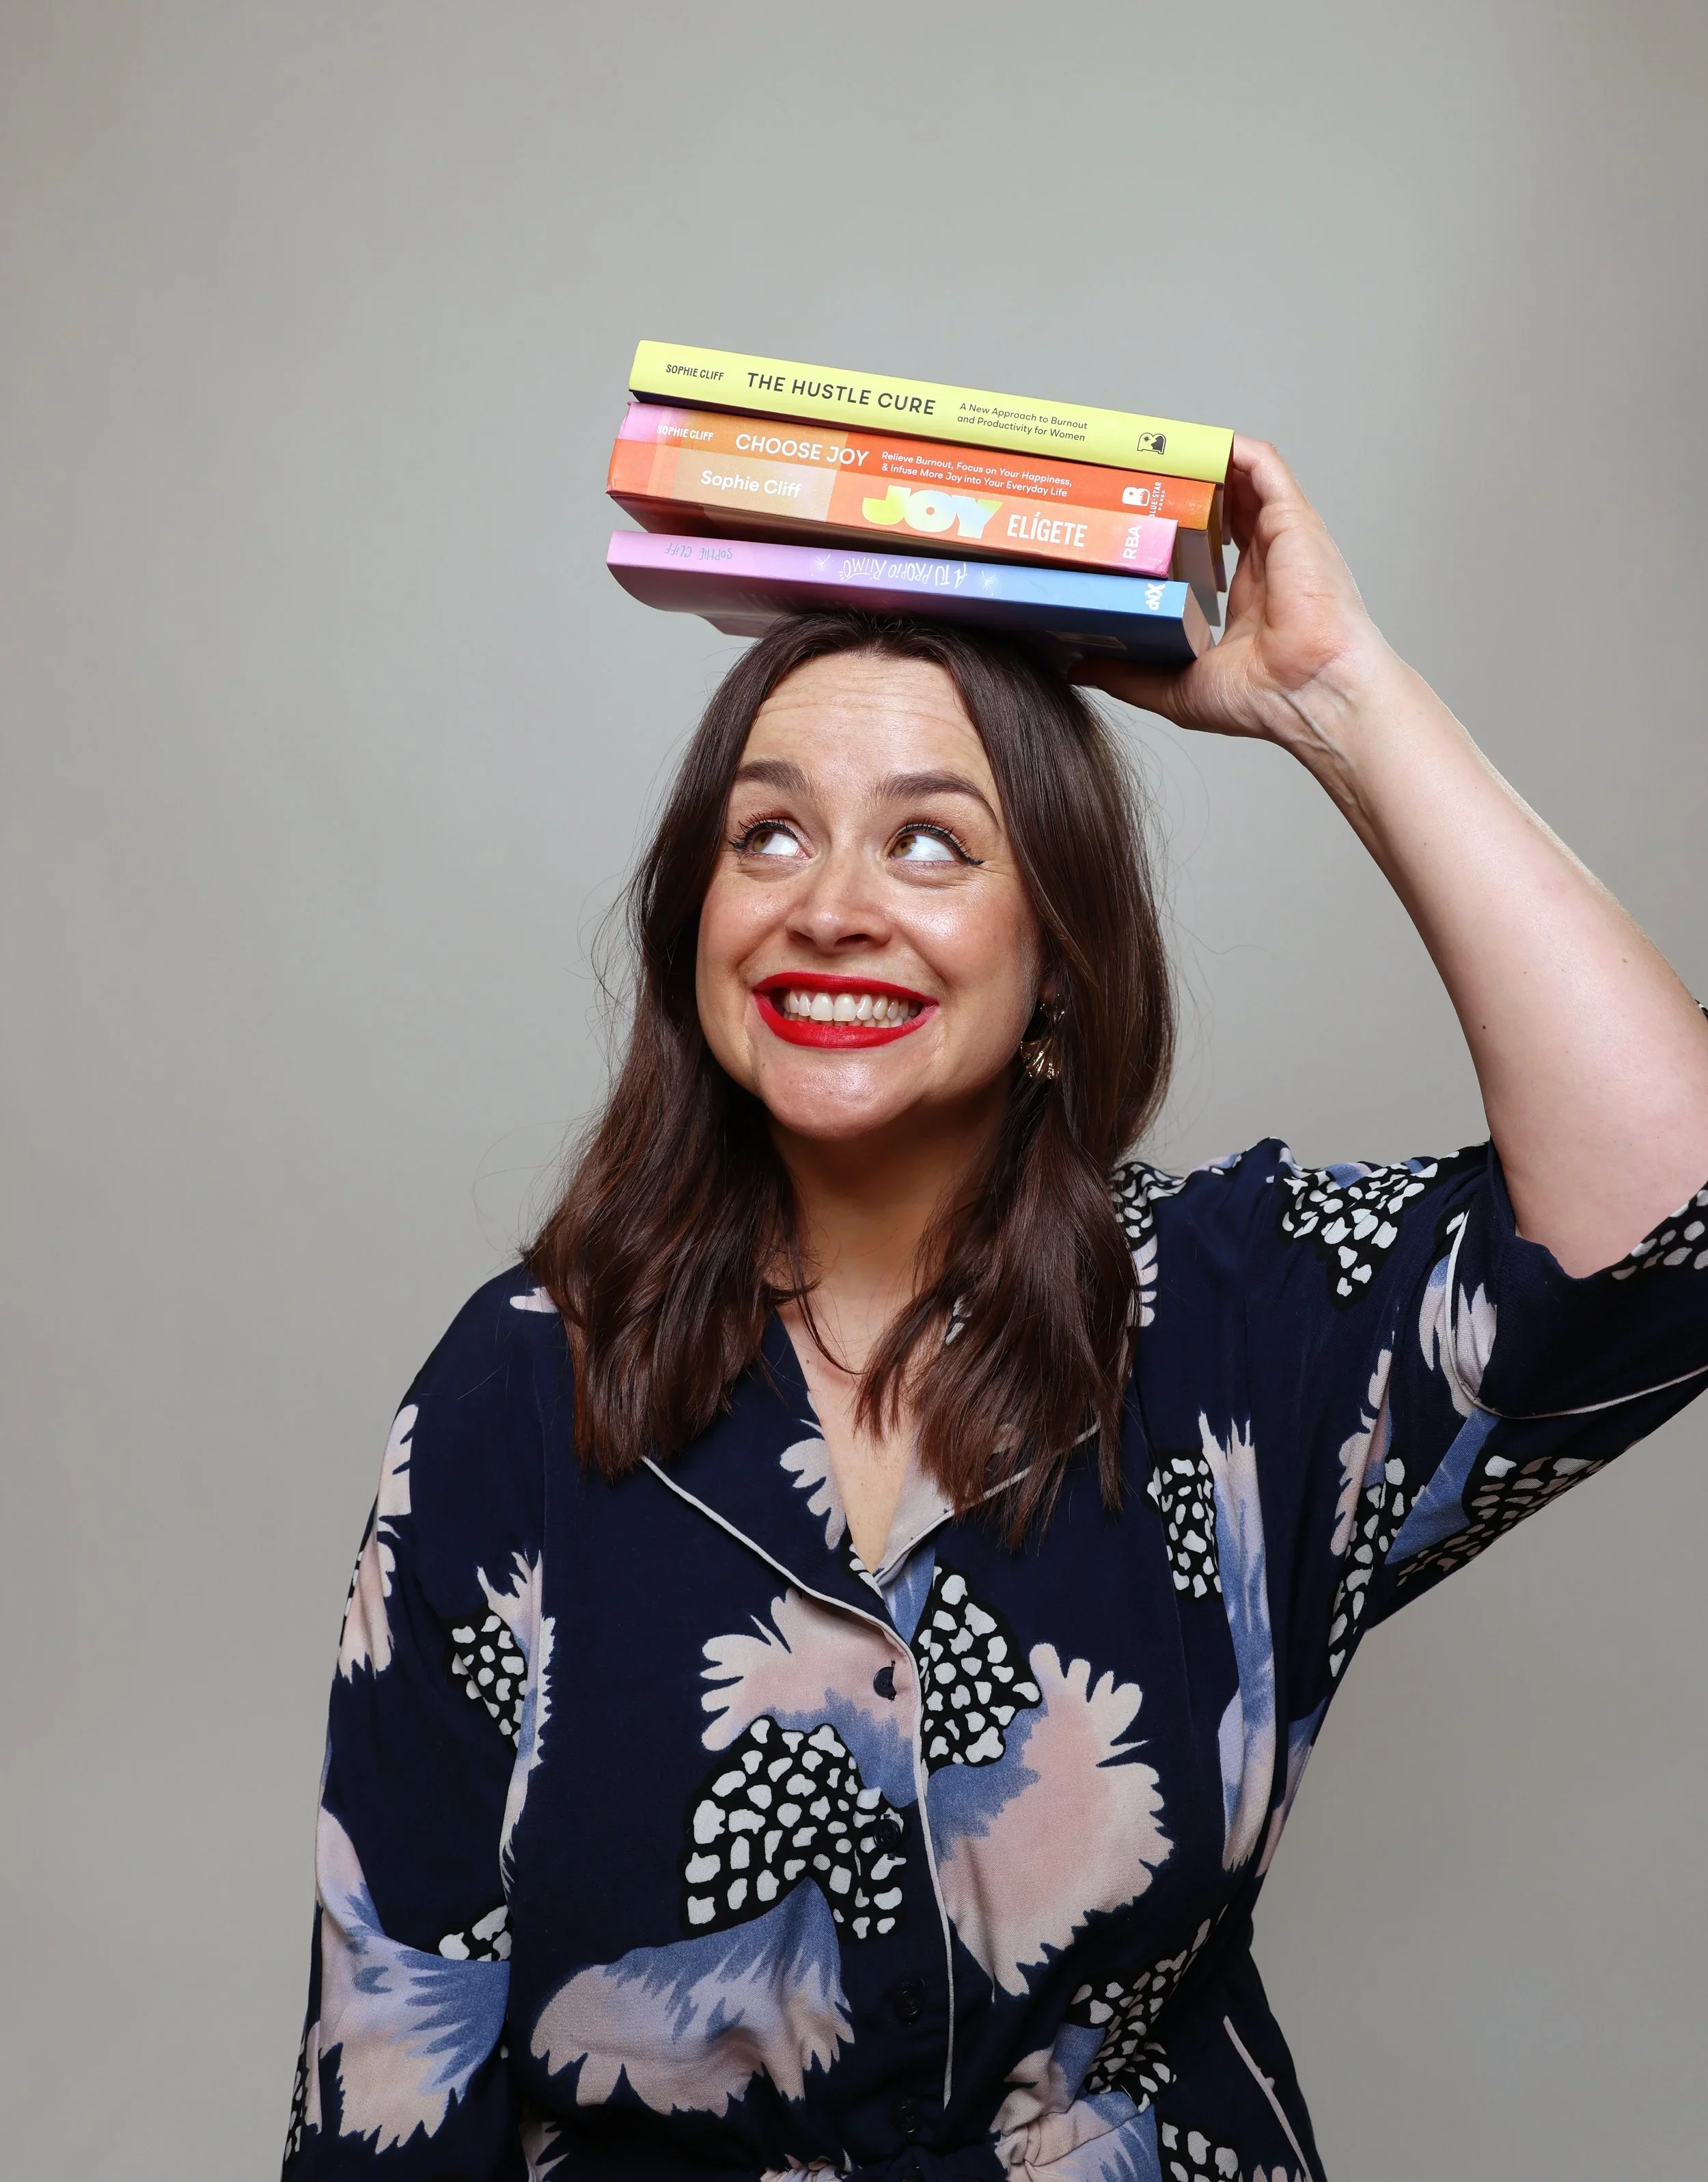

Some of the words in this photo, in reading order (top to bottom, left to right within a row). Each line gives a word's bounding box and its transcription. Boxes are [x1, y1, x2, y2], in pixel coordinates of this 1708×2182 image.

[665, 364, 698, 377] SOPHIE
[700, 370, 724, 381] CLIFF
[747, 372, 786, 392] THE
[791, 379, 871, 405] HUSTLE
[878, 393, 936, 415] CURE
[957, 415, 976, 424] and
[977, 417, 1032, 434] Productivity
[1034, 426, 1048, 437] for
[1050, 428, 1086, 441] Women
[969, 404, 990, 414] New
[991, 408, 1037, 421] Approach
[1051, 417, 1088, 430] Burnout
[657, 425, 689, 438] SOPHIE
[689, 430, 714, 441] CLIFF
[735, 433, 823, 461] CHOOSE
[825, 446, 870, 467] JOY
[700, 470, 760, 492] Sophie
[764, 480, 803, 498] Cliff
[881, 451, 913, 463] Relieve
[915, 456, 954, 470] Burnout,
[956, 462, 984, 473] Focus
[985, 467, 997, 475] on
[1000, 468, 1021, 479] Your
[1021, 471, 1073, 488] Happiness,
[881, 462, 889, 472] &
[890, 464, 918, 476] Infuse
[920, 468, 944, 480] More
[946, 472, 963, 484] Joy
[964, 476, 982, 485] into
[984, 478, 1005, 488] Your
[1006, 480, 1049, 496] Everyday
[1050, 486, 1068, 497] Life
[862, 484, 1004, 539] JOY
[1006, 511, 1088, 547] ELÍGETE
[1122, 525, 1143, 560] RBA
[935, 564, 950, 585] TU
[954, 562, 968, 589] A
